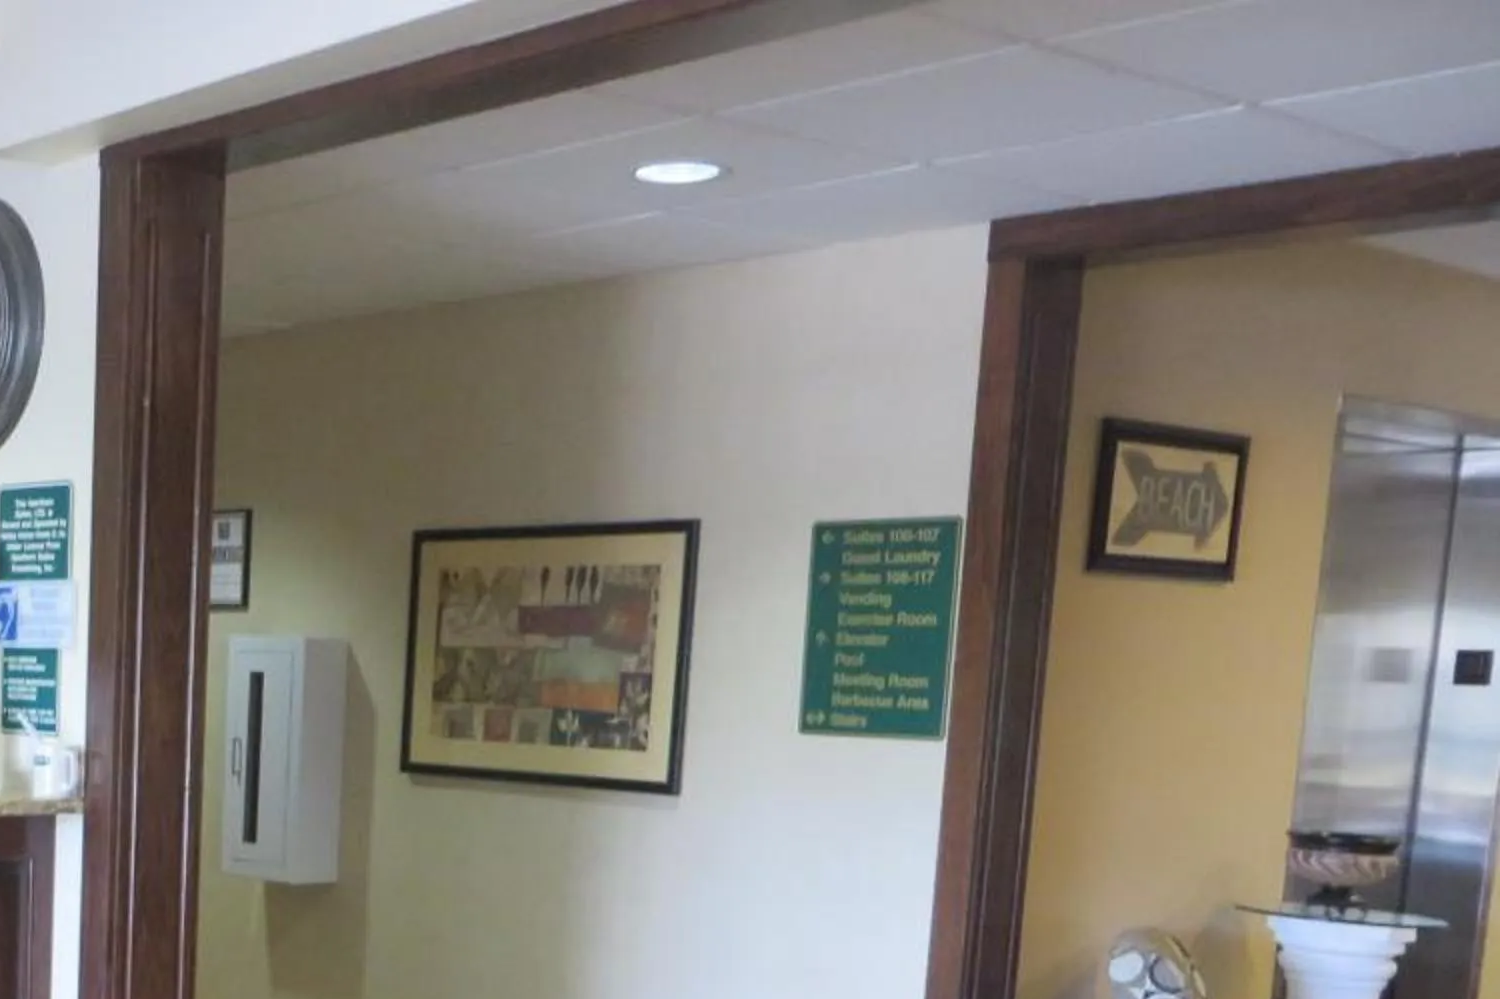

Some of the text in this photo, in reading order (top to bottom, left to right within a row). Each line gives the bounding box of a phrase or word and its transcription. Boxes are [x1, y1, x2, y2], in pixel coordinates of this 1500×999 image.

[1138, 474, 1216, 530] BEACH
[885, 549, 941, 567] Laundry
[838, 591, 893, 609] Vending
[896, 611, 938, 627] Room
[832, 672, 930, 690] Meeting Room
[897, 694, 930, 710] Area
